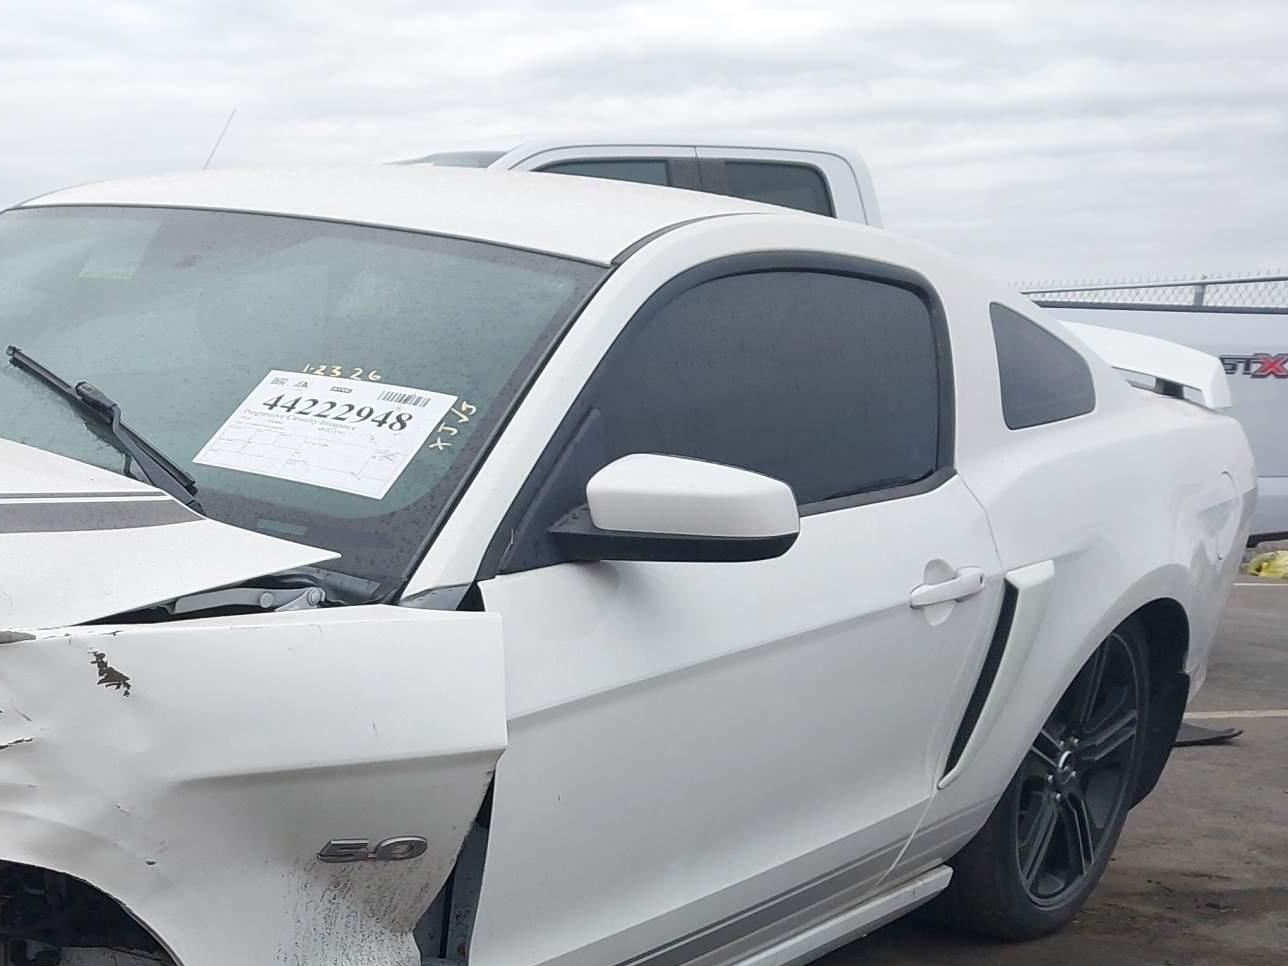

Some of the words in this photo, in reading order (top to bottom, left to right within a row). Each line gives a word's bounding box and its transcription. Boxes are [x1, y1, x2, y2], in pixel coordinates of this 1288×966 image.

[1220, 353, 1288, 378] STX
[262, 394, 413, 432] 44222948
[317, 835, 428, 863] 5.0
